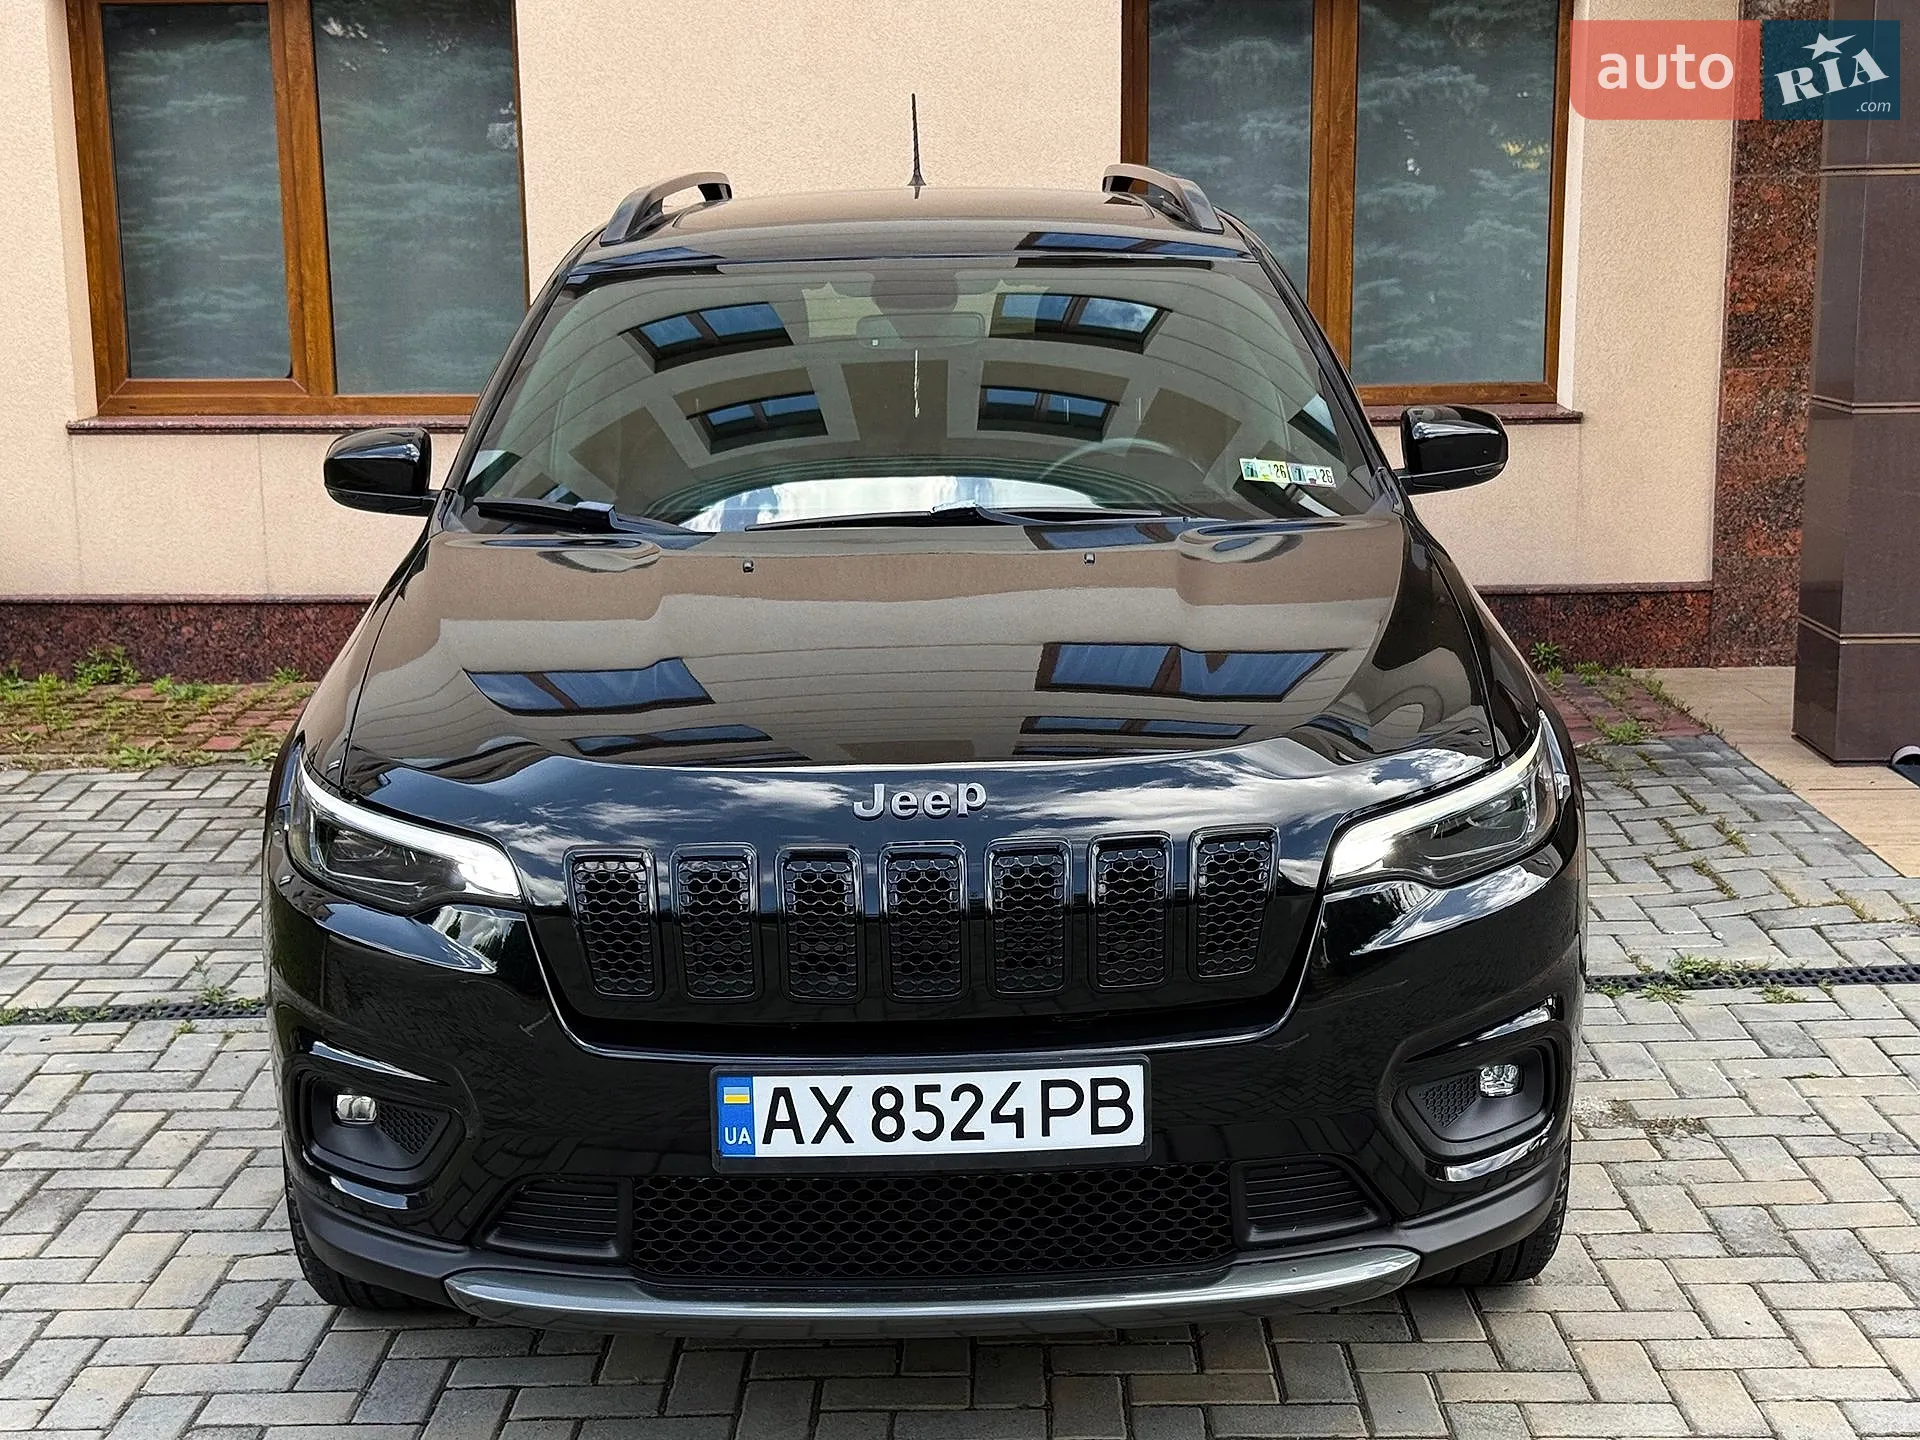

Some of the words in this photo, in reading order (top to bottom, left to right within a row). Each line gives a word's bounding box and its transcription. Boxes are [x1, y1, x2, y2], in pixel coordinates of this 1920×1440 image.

[852, 782, 987, 821] Jeep
[761, 1085, 855, 1145] AX
[871, 1081, 1025, 1143] 8524
[1040, 1076, 1135, 1138] PB
[724, 1127, 752, 1145] UA
